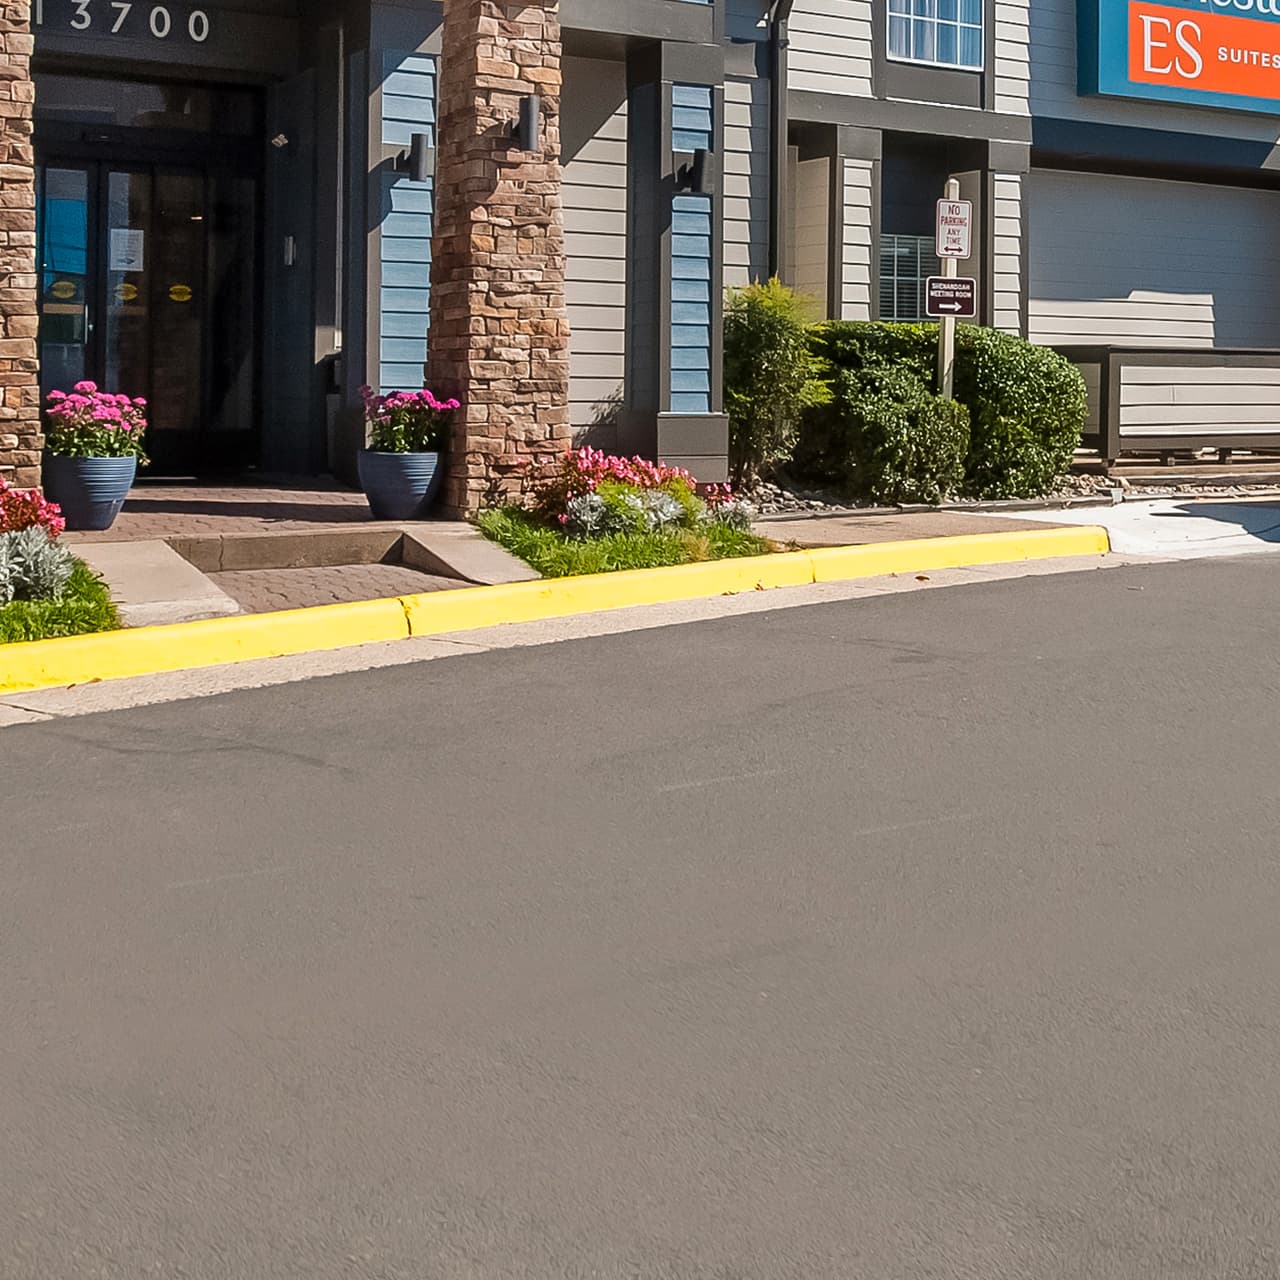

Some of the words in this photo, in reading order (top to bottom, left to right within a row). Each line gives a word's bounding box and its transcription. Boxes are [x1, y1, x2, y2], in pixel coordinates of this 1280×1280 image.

[1138, 13, 1203, 79] ES
[948, 204, 961, 216] NO
[941, 215, 968, 227] PARKING
[947, 228, 961, 236] ANY
[946, 236, 962, 245] TIME
